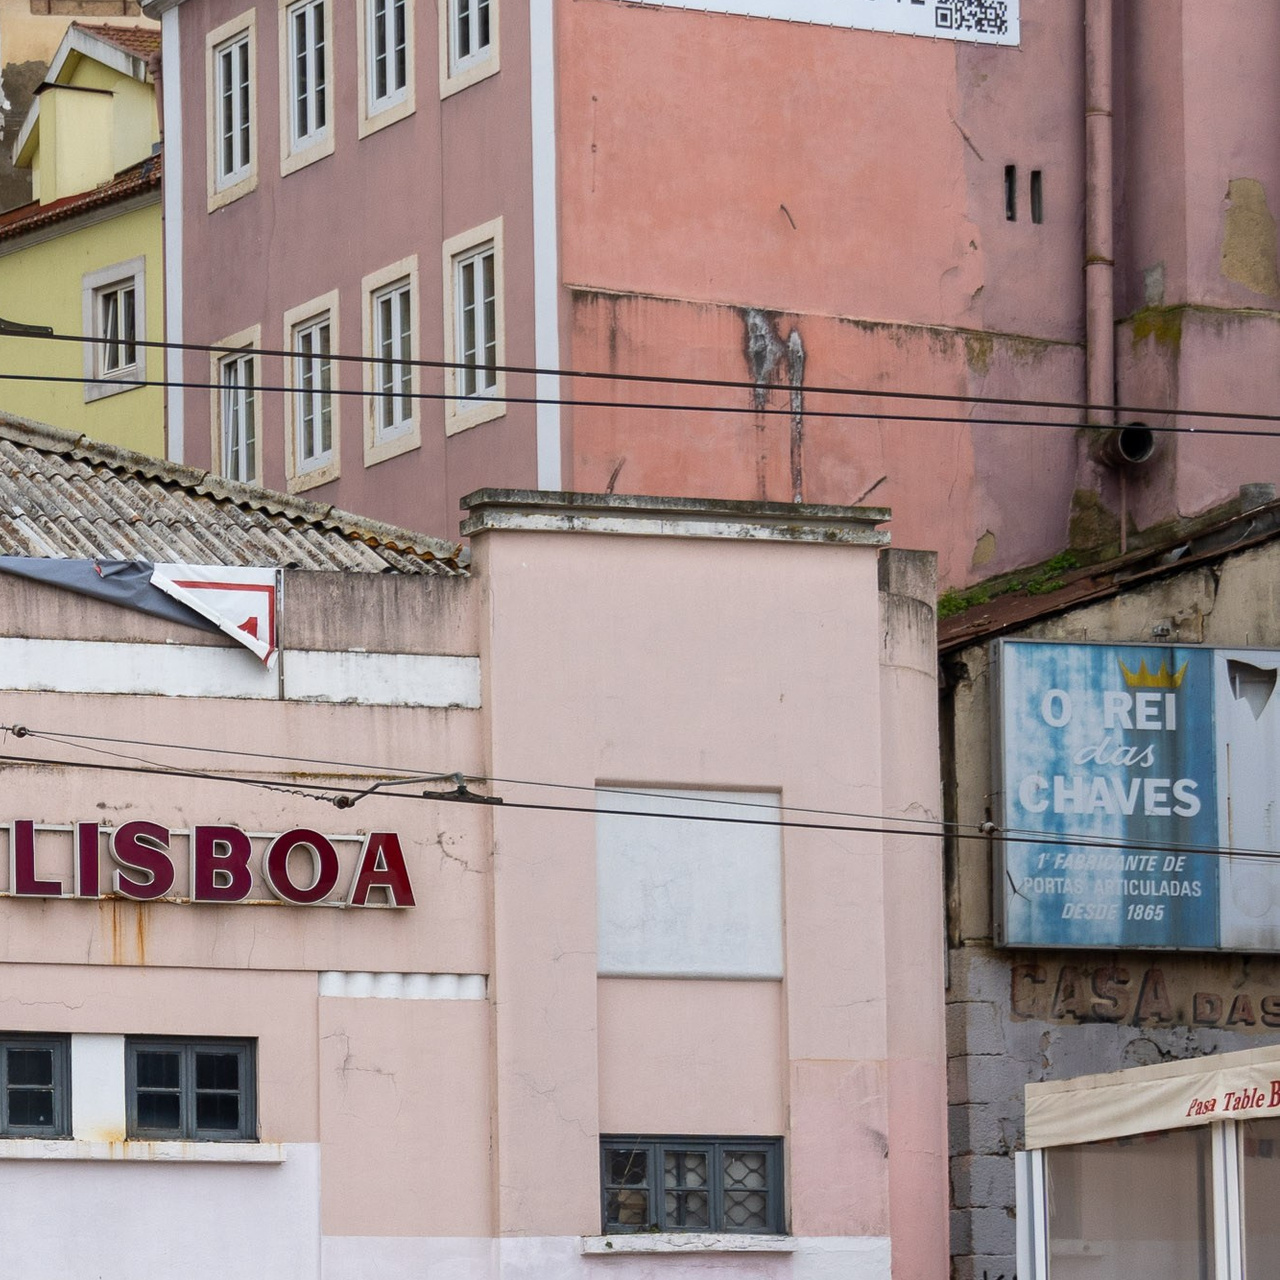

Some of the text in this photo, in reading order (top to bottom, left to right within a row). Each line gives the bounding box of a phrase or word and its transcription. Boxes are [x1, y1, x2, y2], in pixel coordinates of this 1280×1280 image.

[1041, 689, 1177, 731] O REI
[1073, 736, 1155, 768] das
[1019, 775, 1201, 818] CHAVES
[9, 819, 417, 908] LISBOA
[1054, 853, 1158, 872] FABRICANTE
[1163, 855, 1186, 872] DE
[1023, 877, 1202, 897] PORTAS ARTICULADAS
[1062, 903, 1165, 921] DESDE 1865
[1011, 964, 1172, 1025] CASA
[1222, 1087, 1265, 1111] Table
